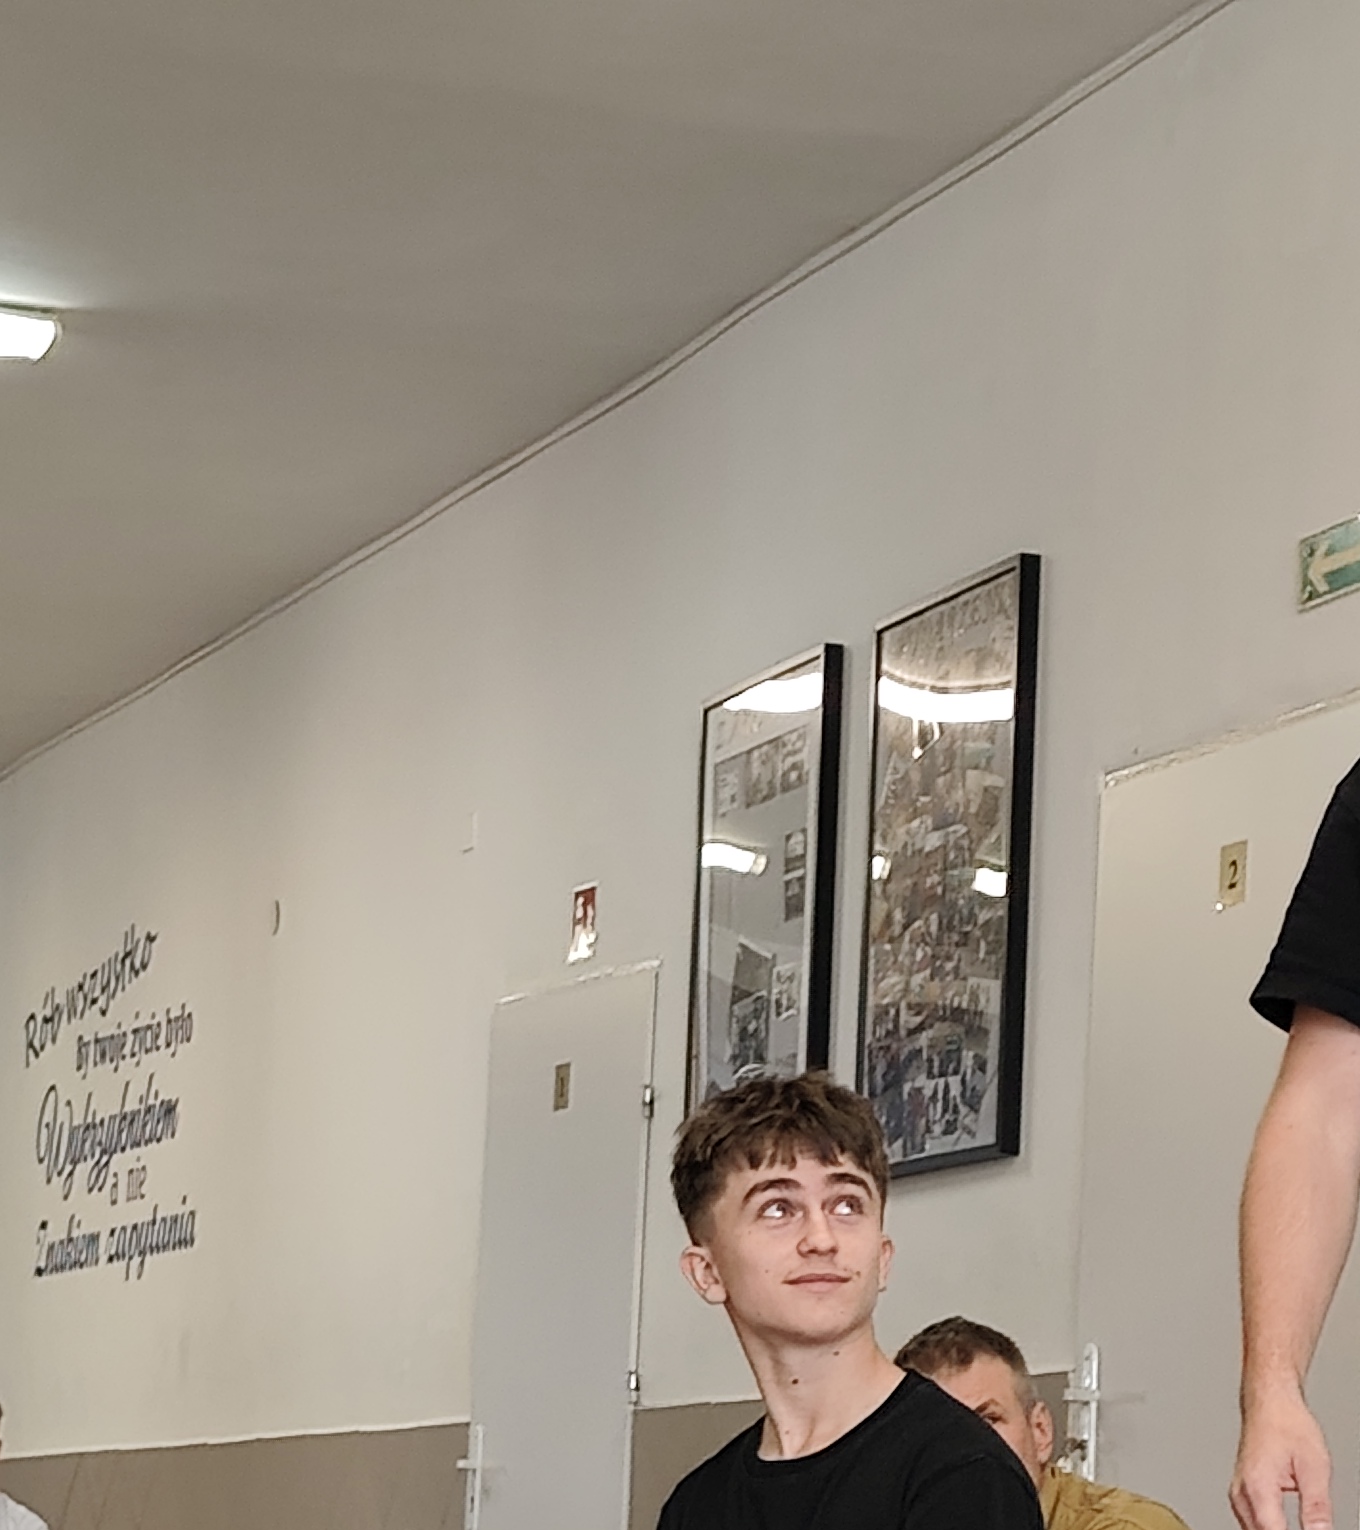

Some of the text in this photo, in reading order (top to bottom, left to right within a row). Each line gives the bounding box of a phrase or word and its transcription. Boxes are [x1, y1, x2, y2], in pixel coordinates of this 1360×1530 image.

[1228, 859, 1241, 890] 2
[24, 922, 159, 1069] Rób wszystko
[93, 1021, 128, 1074] twoje
[164, 1002, 194, 1059] było
[110, 1156, 148, 1206] a nie
[33, 1194, 197, 1282] Znakiem zapytania
